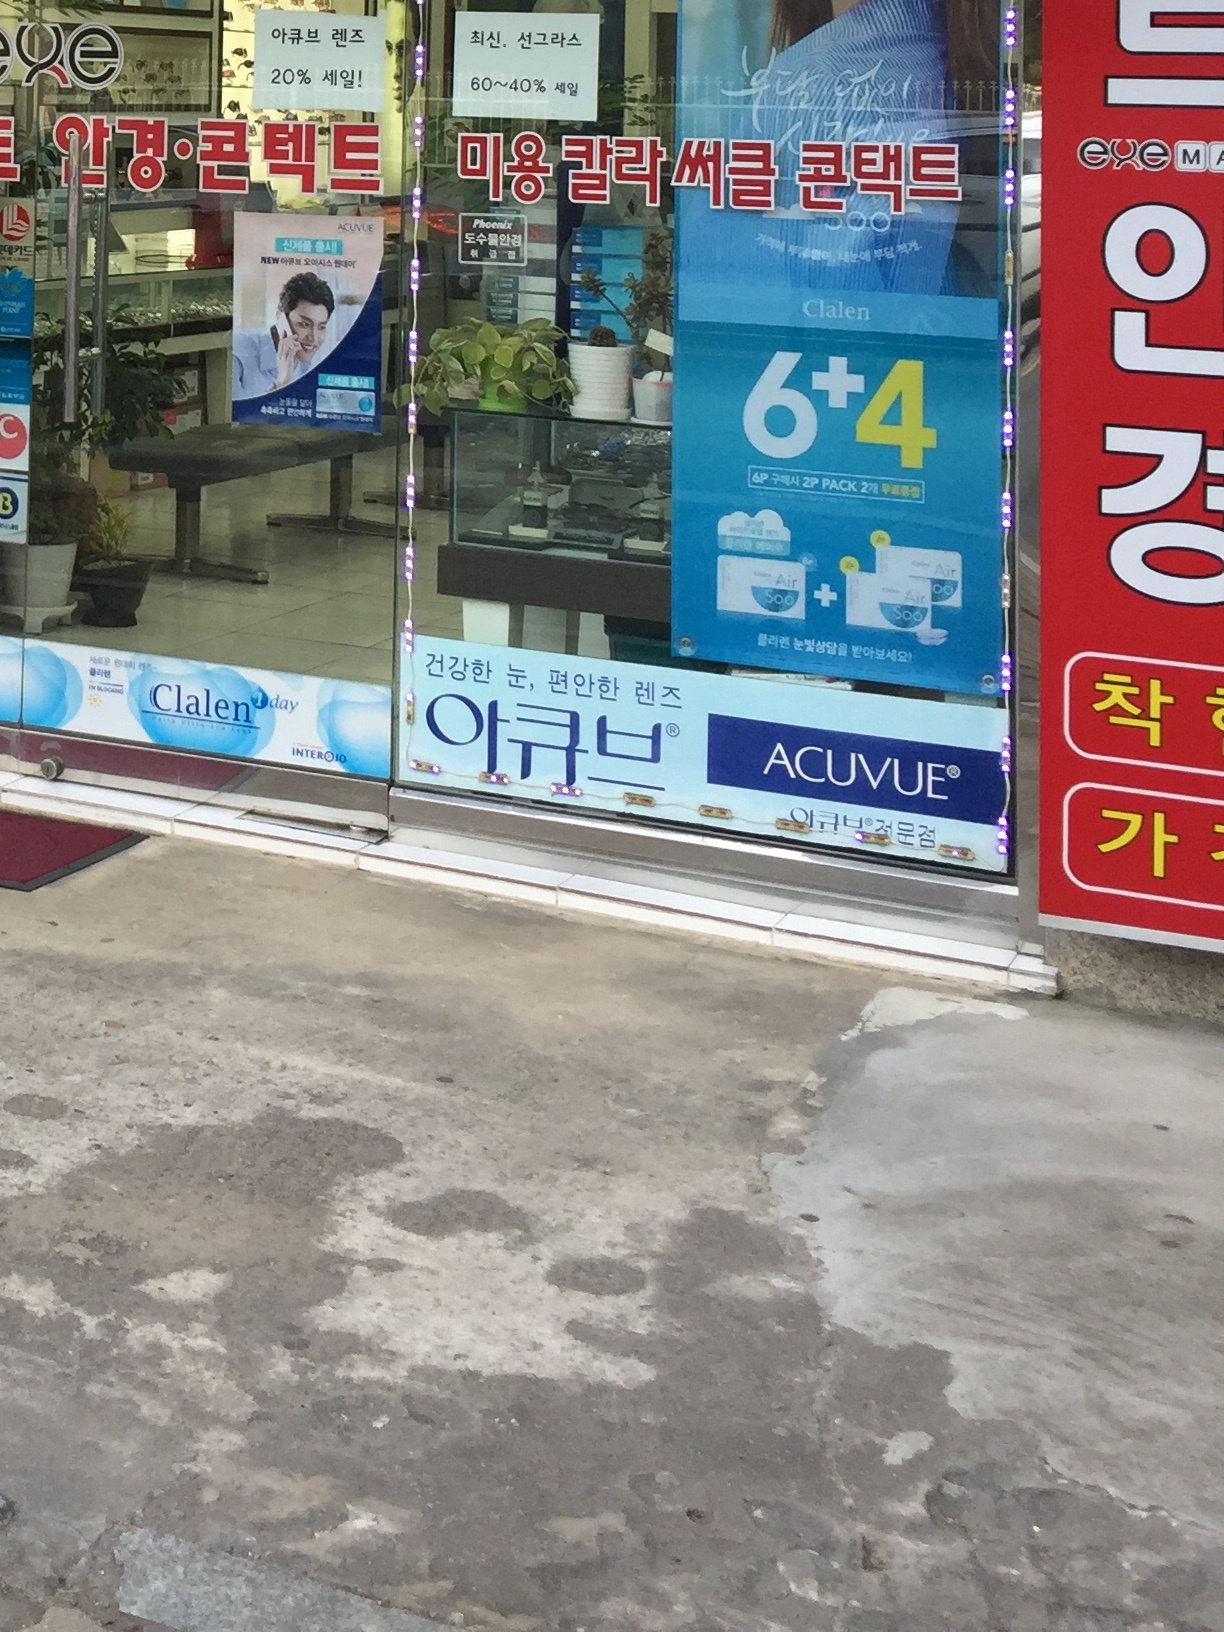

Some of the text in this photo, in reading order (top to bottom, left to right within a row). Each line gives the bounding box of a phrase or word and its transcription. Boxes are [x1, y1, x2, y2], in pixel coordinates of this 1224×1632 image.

[271, 28, 365, 48] 아큐브 렌즈
[518, 32, 582, 49] 선그라스
[271, 68, 362, 89] 20% 세일!
[471, 77, 578, 96] 60~40% 세일
[457, 131, 554, 206] 미용
[671, 137, 779, 210] 써클
[796, 141, 963, 215] 콘택트
[337, 223, 374, 232] ACUVUE
[473, 219, 513, 229] Phoenix
[283, 240, 311, 252] 신제품
[281, 257, 301, 265] 아큐브
[304, 258, 332, 267] 오아시스
[802, 299, 871, 322] Clalen
[752, 471, 769, 484] 6P
[803, 477, 819, 489] 2P
[822, 479, 857, 493] PACK
[776, 574, 798, 588] Air
[905, 590, 926, 604] Air
[425, 652, 683, 710] 건강한 눈, 편안한 렌즈
[96, 686, 124, 695] BLOCKING
[149, 683, 252, 724] Clalen
